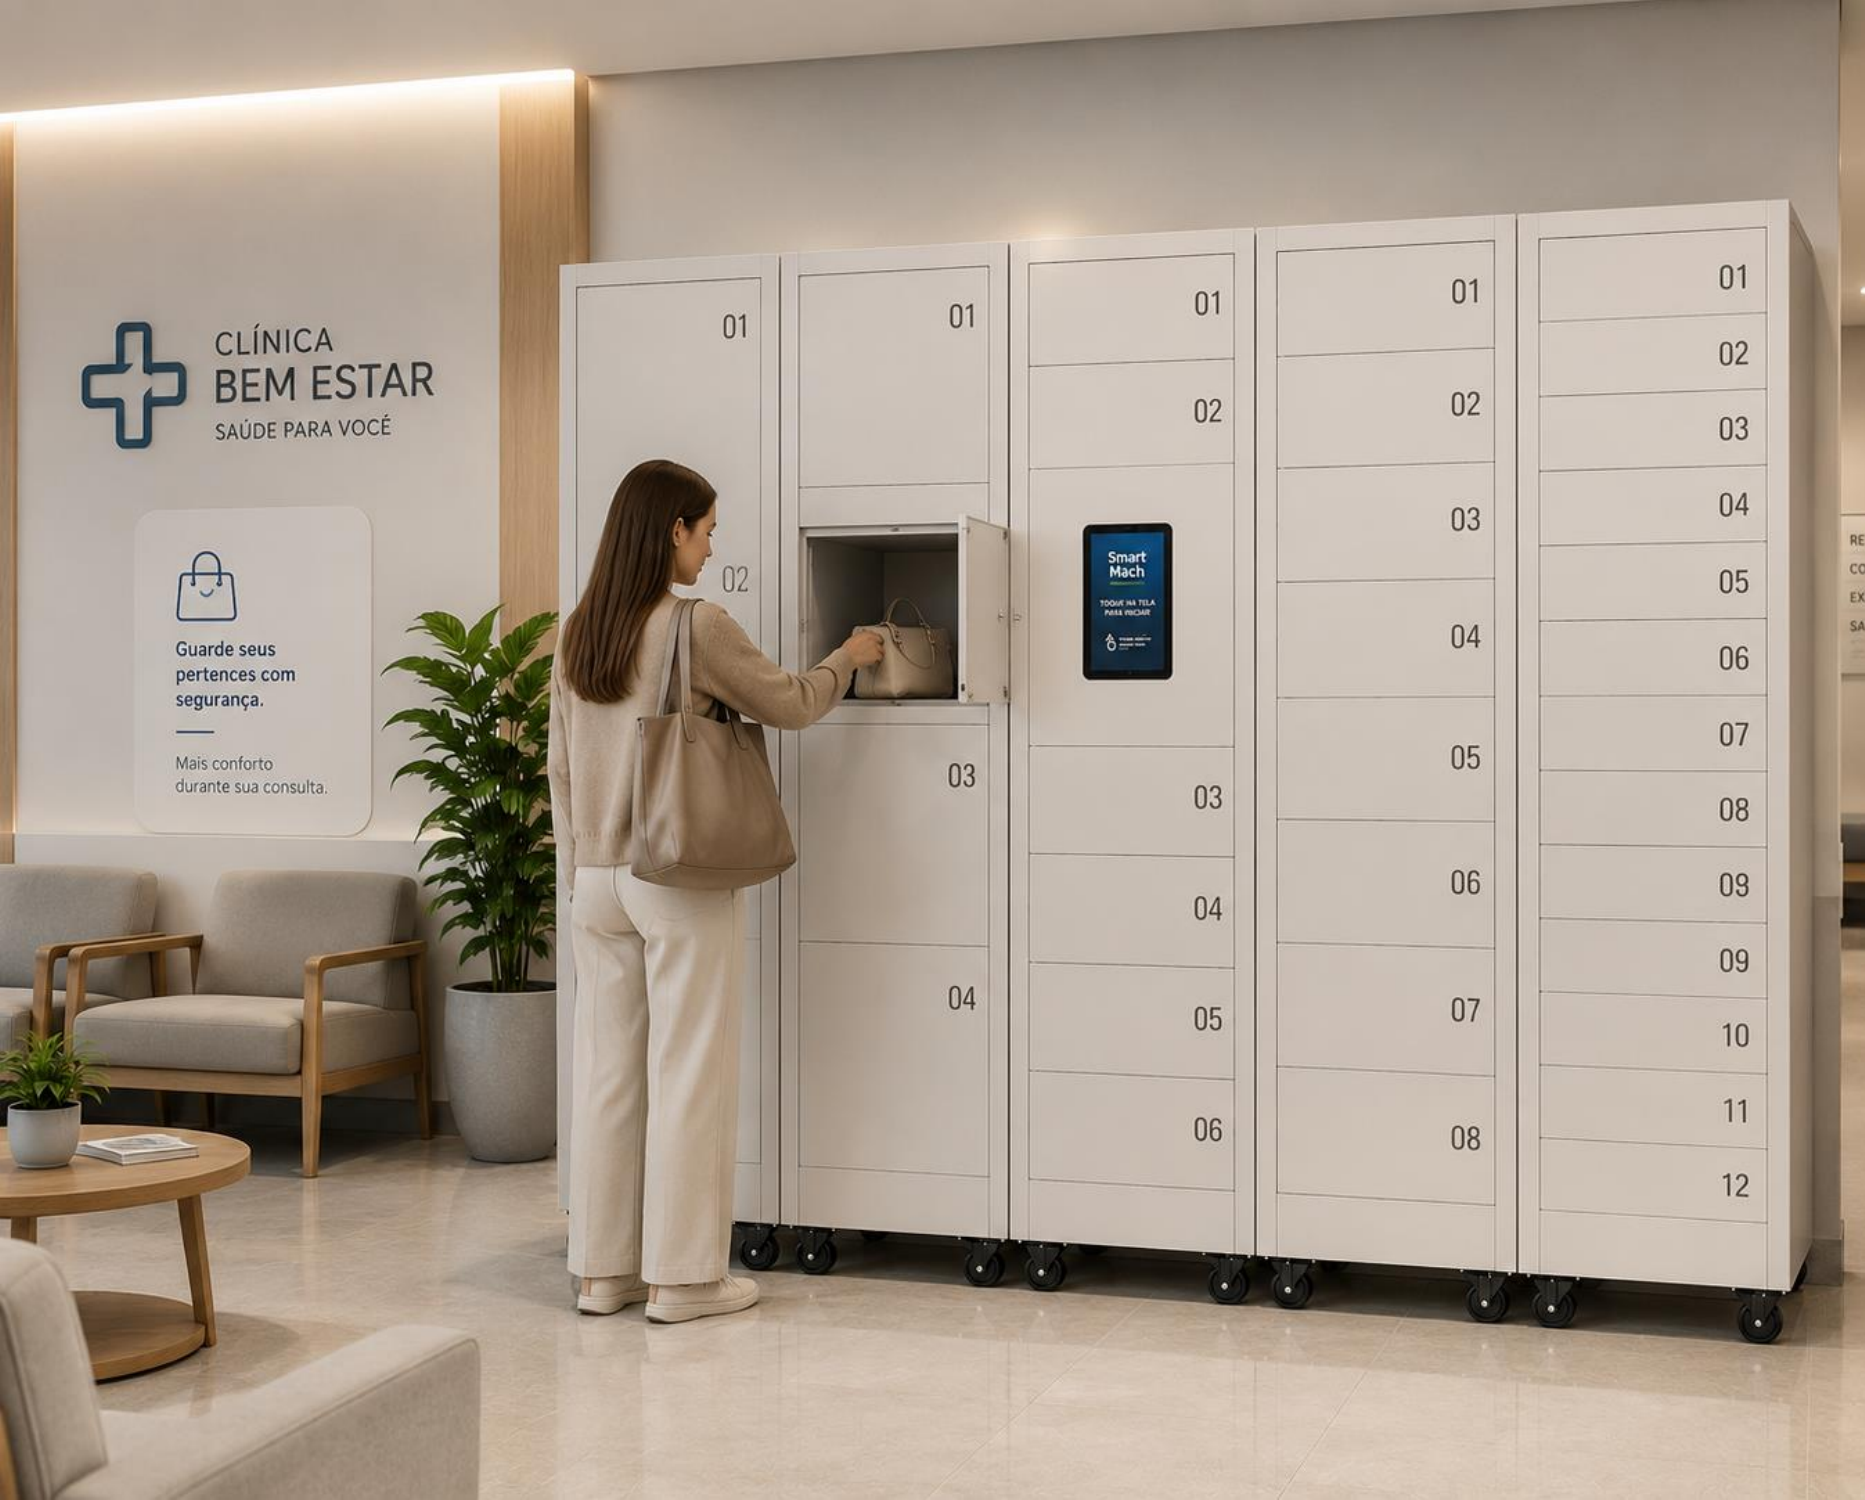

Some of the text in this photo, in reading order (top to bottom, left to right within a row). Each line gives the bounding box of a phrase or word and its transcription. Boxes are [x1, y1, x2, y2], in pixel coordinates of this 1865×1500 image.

[1720, 265, 1745, 290] 01
[1196, 291, 1219, 315] 01
[1452, 279, 1477, 304] 01
[724, 314, 746, 339] 01
[950, 304, 973, 328] 01
[215, 323, 334, 357] CLÍNICA
[1720, 341, 1748, 366] 02
[215, 361, 434, 404] BEM ESTAR
[1195, 399, 1221, 423] 02
[1452, 392, 1480, 416] 02
[215, 418, 277, 441] SAÚDE
[283, 420, 333, 438] PARA
[1720, 417, 1748, 440] 03
[1720, 493, 1749, 517] 04
[1452, 507, 1480, 531] 03
[1108, 551, 1147, 564] Smart
[723, 566, 748, 592] 02
[1110, 565, 1145, 578] Mach
[1720, 570, 1748, 593] 05
[175, 640, 276, 657] Guarde seus
[1452, 625, 1480, 648] 04
[1720, 646, 1749, 670] 06
[175, 665, 296, 687] pertences com
[175, 691, 264, 712] segurança.
[1720, 723, 1748, 746] 07
[176, 755, 274, 771] Mais conforto
[1452, 745, 1480, 770] 05
[175, 778, 328, 795] durante sua consulta.
[949, 763, 975, 787] 03
[1195, 785, 1222, 809] 03
[1720, 798, 1749, 821] 08
[1452, 870, 1480, 894] 06
[1195, 896, 1222, 920] 04
[1720, 949, 1748, 972] 09
[949, 986, 975, 1010] 04
[1452, 997, 1480, 1022] 07
[1195, 1007, 1222, 1031] 05
[1723, 1023, 1749, 1047] 10
[1724, 1099, 1746, 1123] 11
[1195, 1117, 1222, 1141] 06
[1452, 1126, 1480, 1150] 08
[1723, 1173, 1748, 1197] 12
